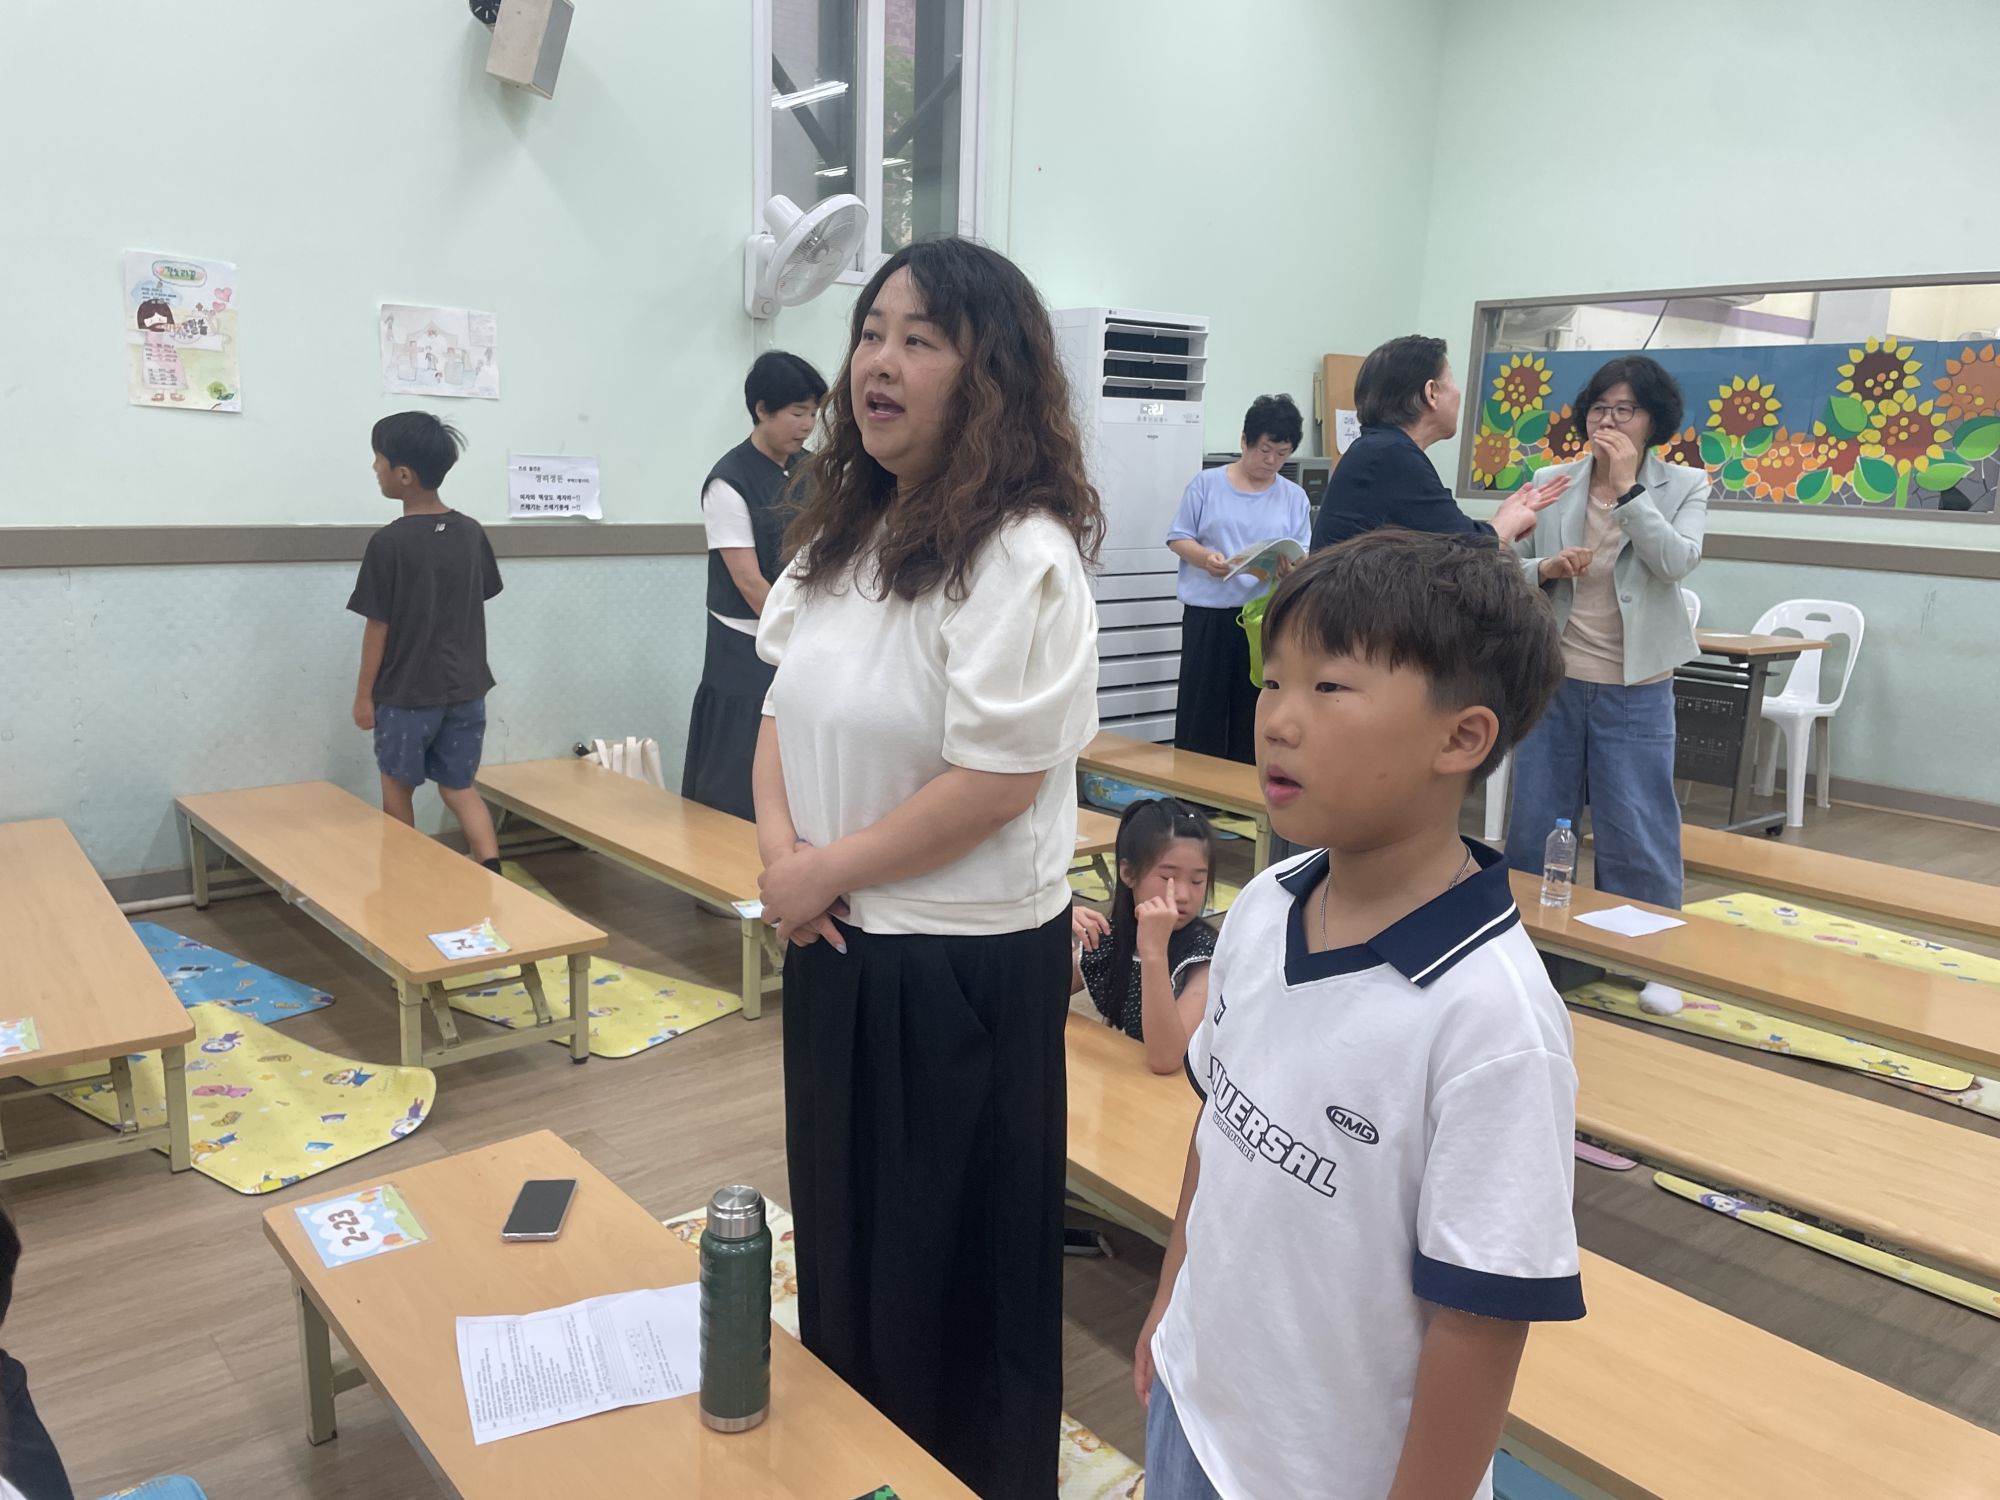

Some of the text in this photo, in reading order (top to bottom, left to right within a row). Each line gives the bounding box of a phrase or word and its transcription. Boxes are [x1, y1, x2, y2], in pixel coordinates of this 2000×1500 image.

[535, 474, 564, 484] 정리정돈
[1207, 1053, 1337, 1198] NIVERSAL
[1330, 1108, 1376, 1141] OMG
[328, 1209, 370, 1247] 2-23
